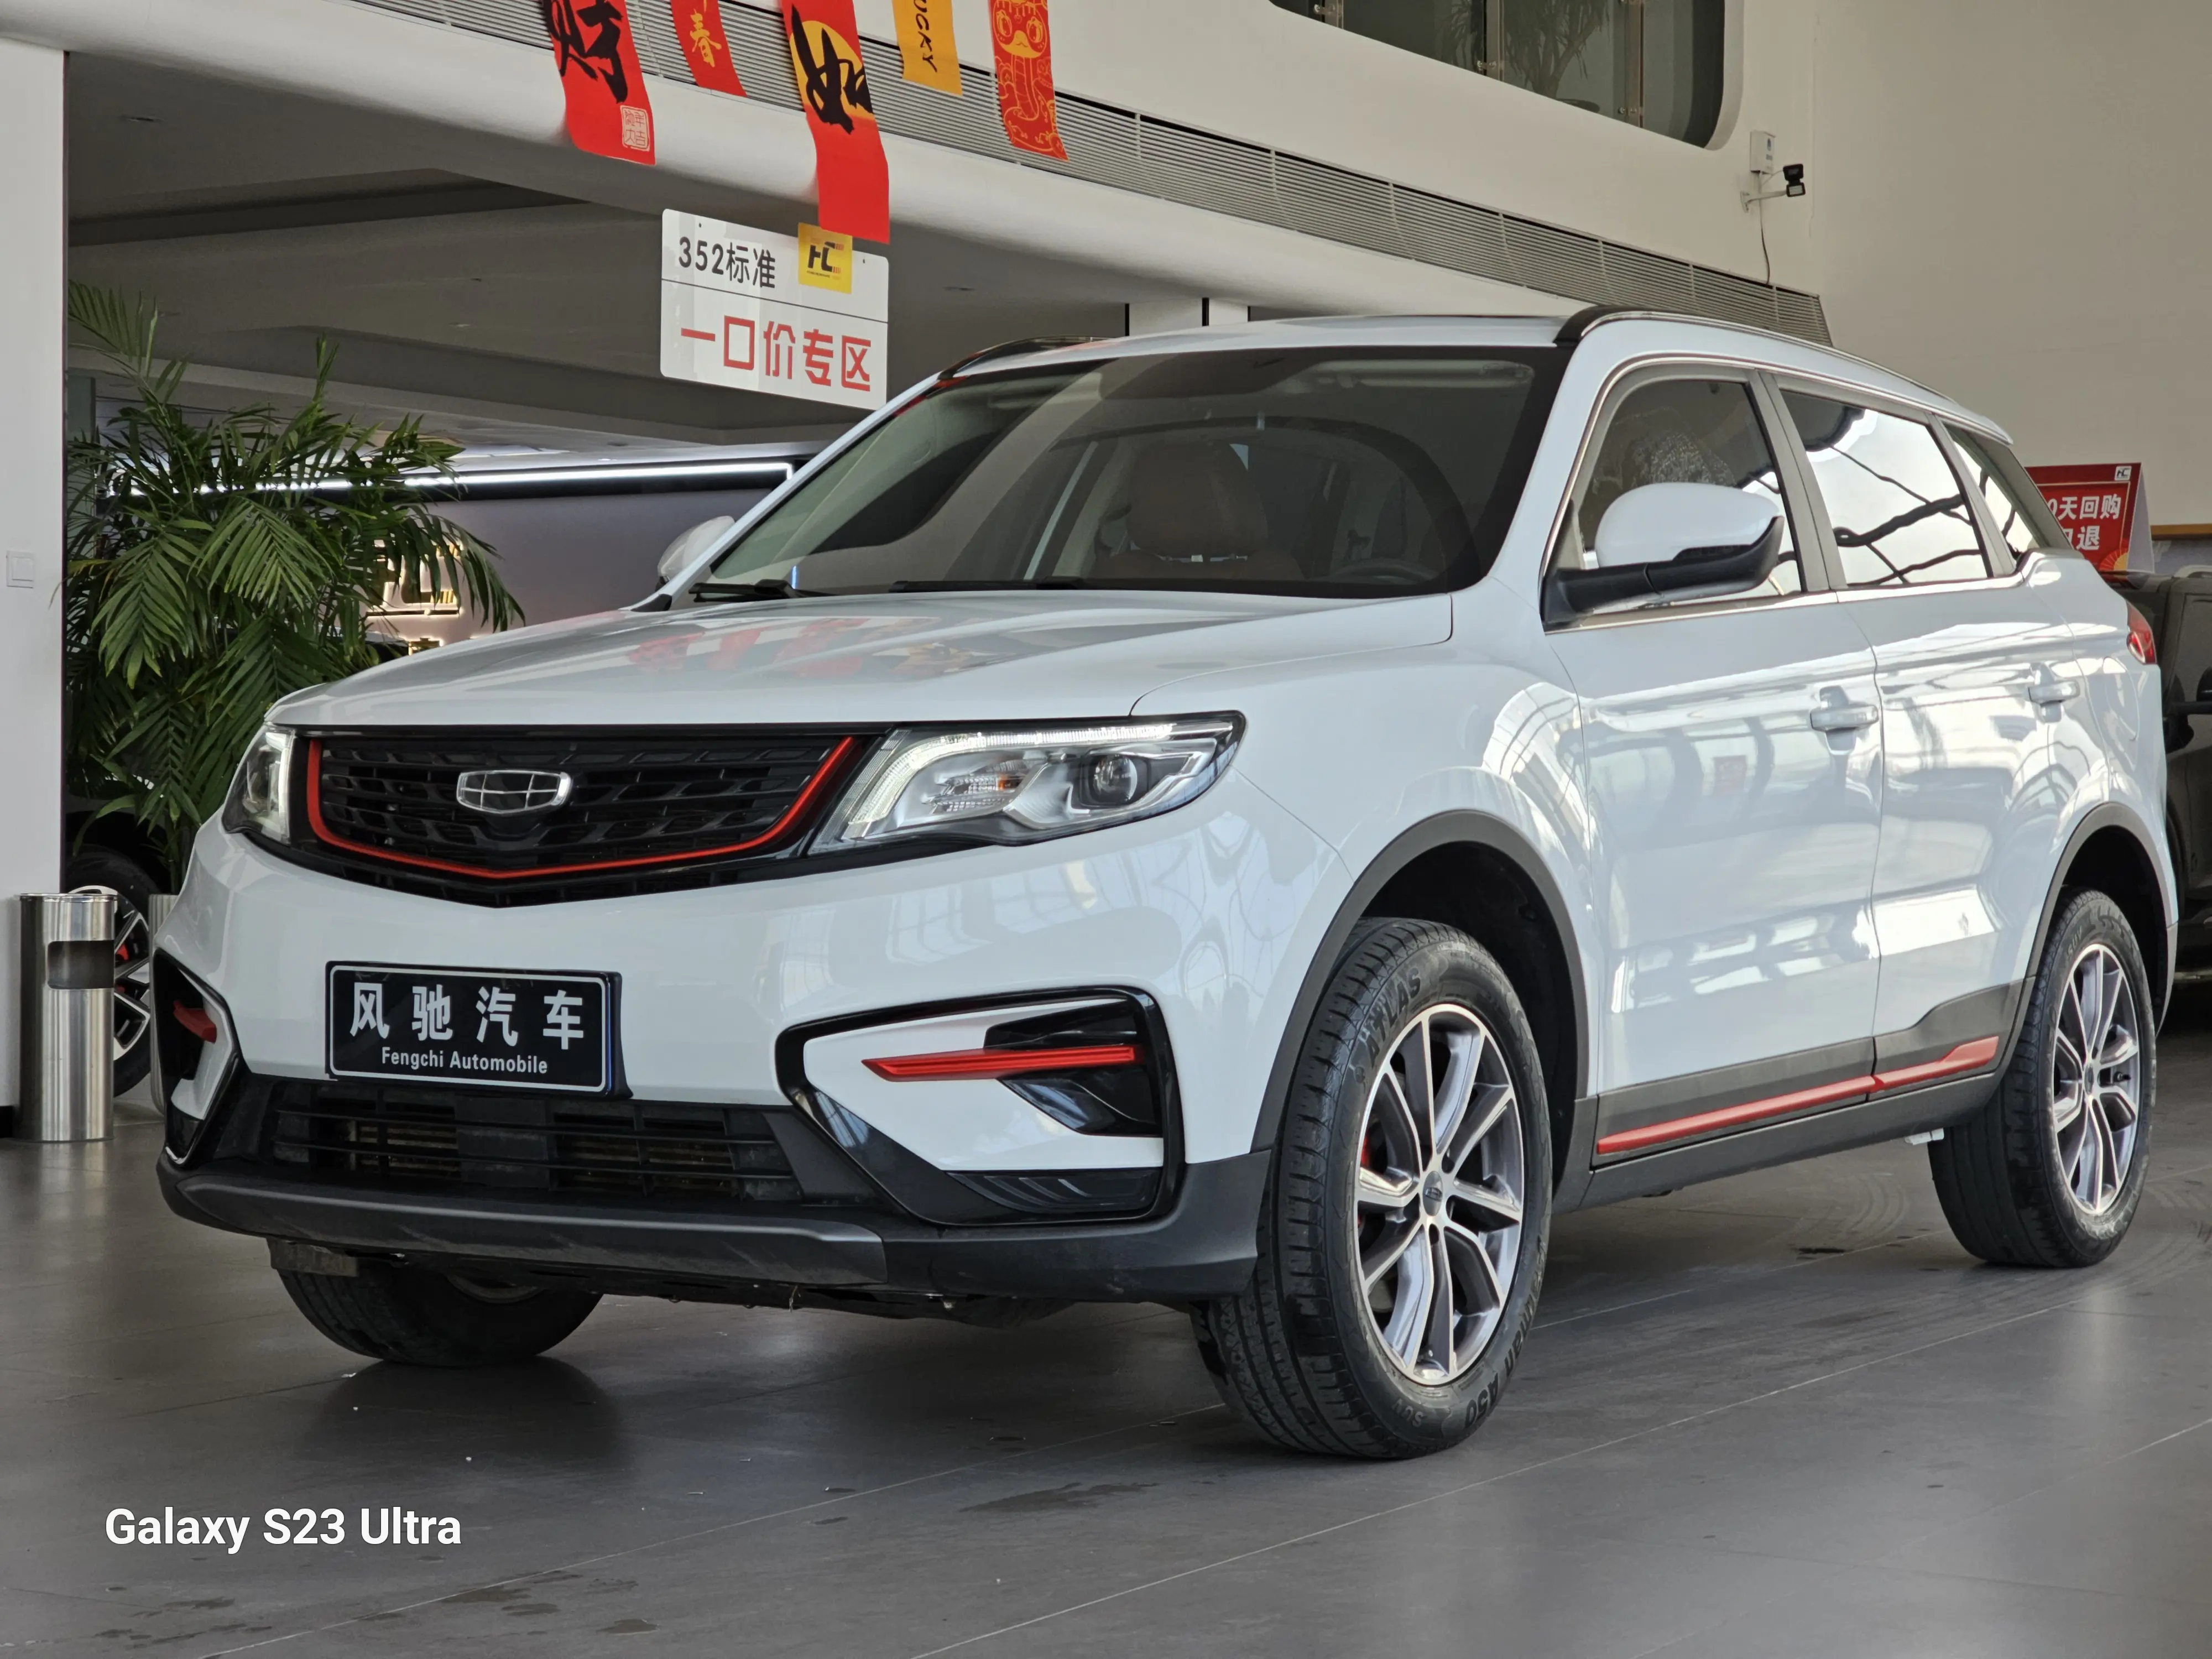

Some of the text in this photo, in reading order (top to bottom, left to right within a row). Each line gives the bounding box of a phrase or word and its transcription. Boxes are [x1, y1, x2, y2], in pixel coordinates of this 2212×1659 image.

[690, 0, 722, 67] 春
[679, 236, 775, 288] 352标准
[681, 315, 871, 392] 一口价专区
[350, 982, 584, 1050] 风驰汽车
[1361, 968, 1420, 1068] ATLAS
[382, 1047, 548, 1074] Fengchi Automobile
